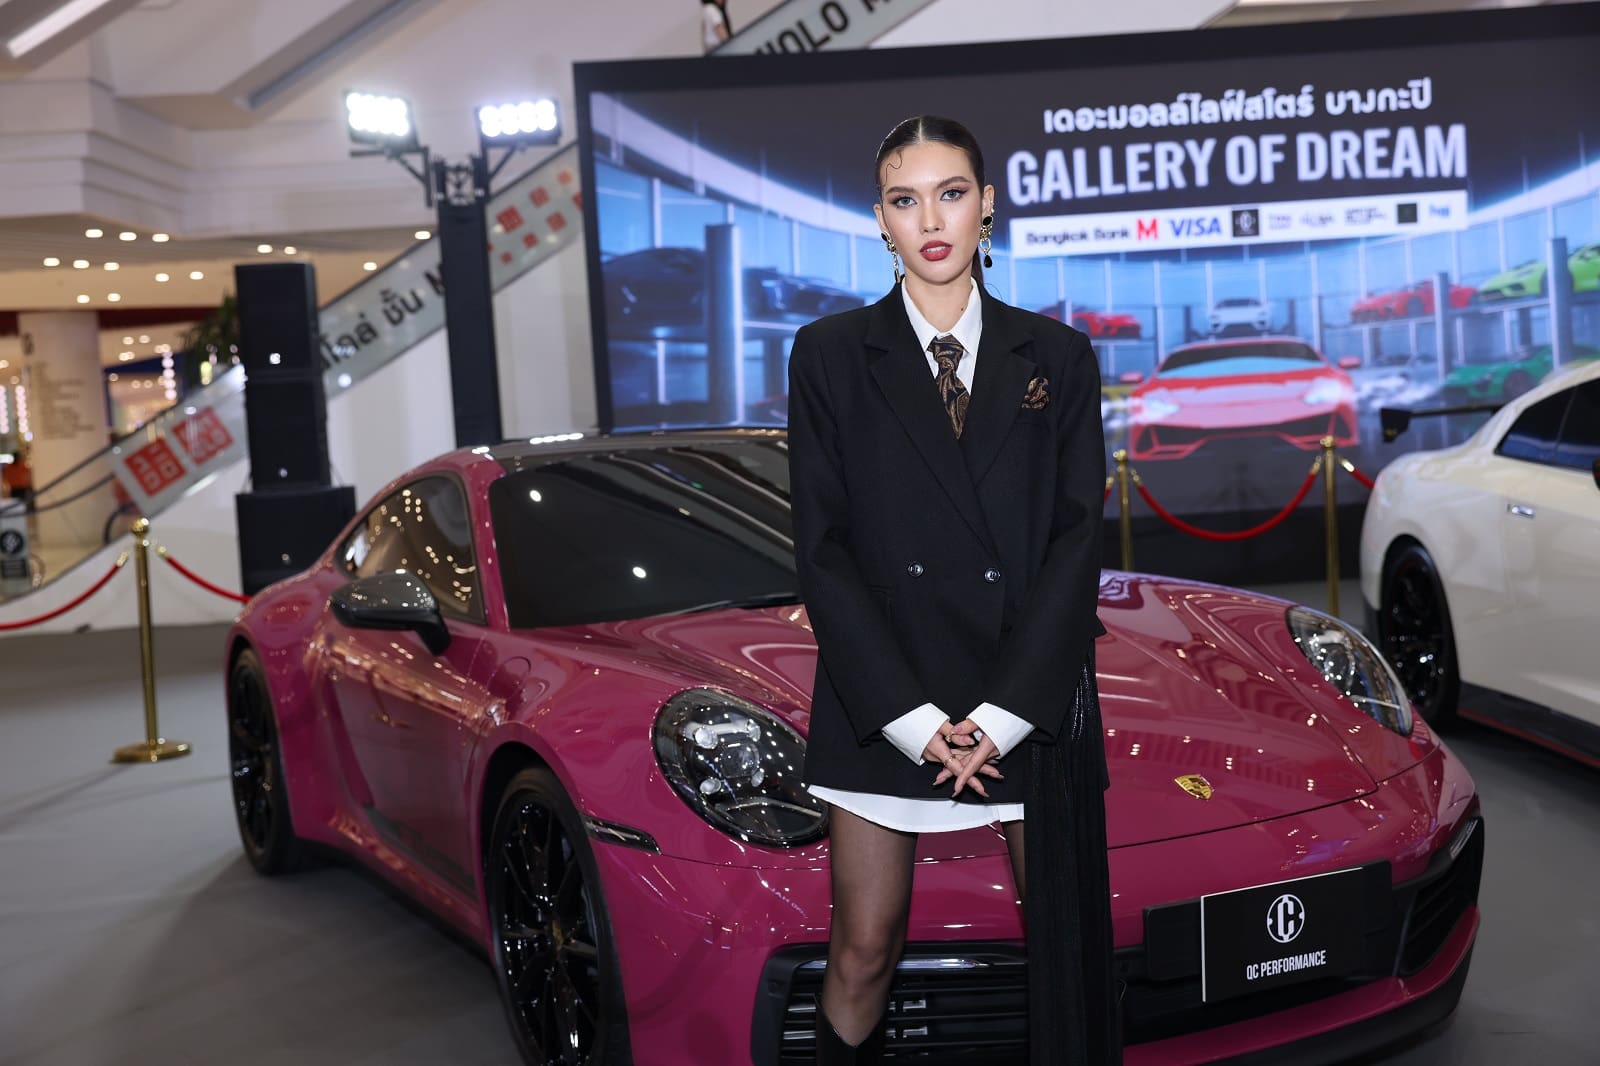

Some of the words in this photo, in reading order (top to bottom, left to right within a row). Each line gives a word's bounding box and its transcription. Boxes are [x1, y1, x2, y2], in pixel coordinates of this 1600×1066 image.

[1043, 84, 1315, 134] เดอะมอลล์ไลฟ์สโตร์
[1325, 76, 1432, 116] บางกะปิ
[1006, 138, 1217, 206] GALLERY
[1225, 133, 1287, 186] OF
[1296, 123, 1467, 182] DREAM
[1026, 228, 1088, 245] Bangkok
[1093, 227, 1129, 240] Bank
[1137, 218, 1158, 240] M
[1169, 217, 1221, 237] VISA
[1246, 963, 1259, 981] QC
[1260, 950, 1327, 978] PERFORMANCE
